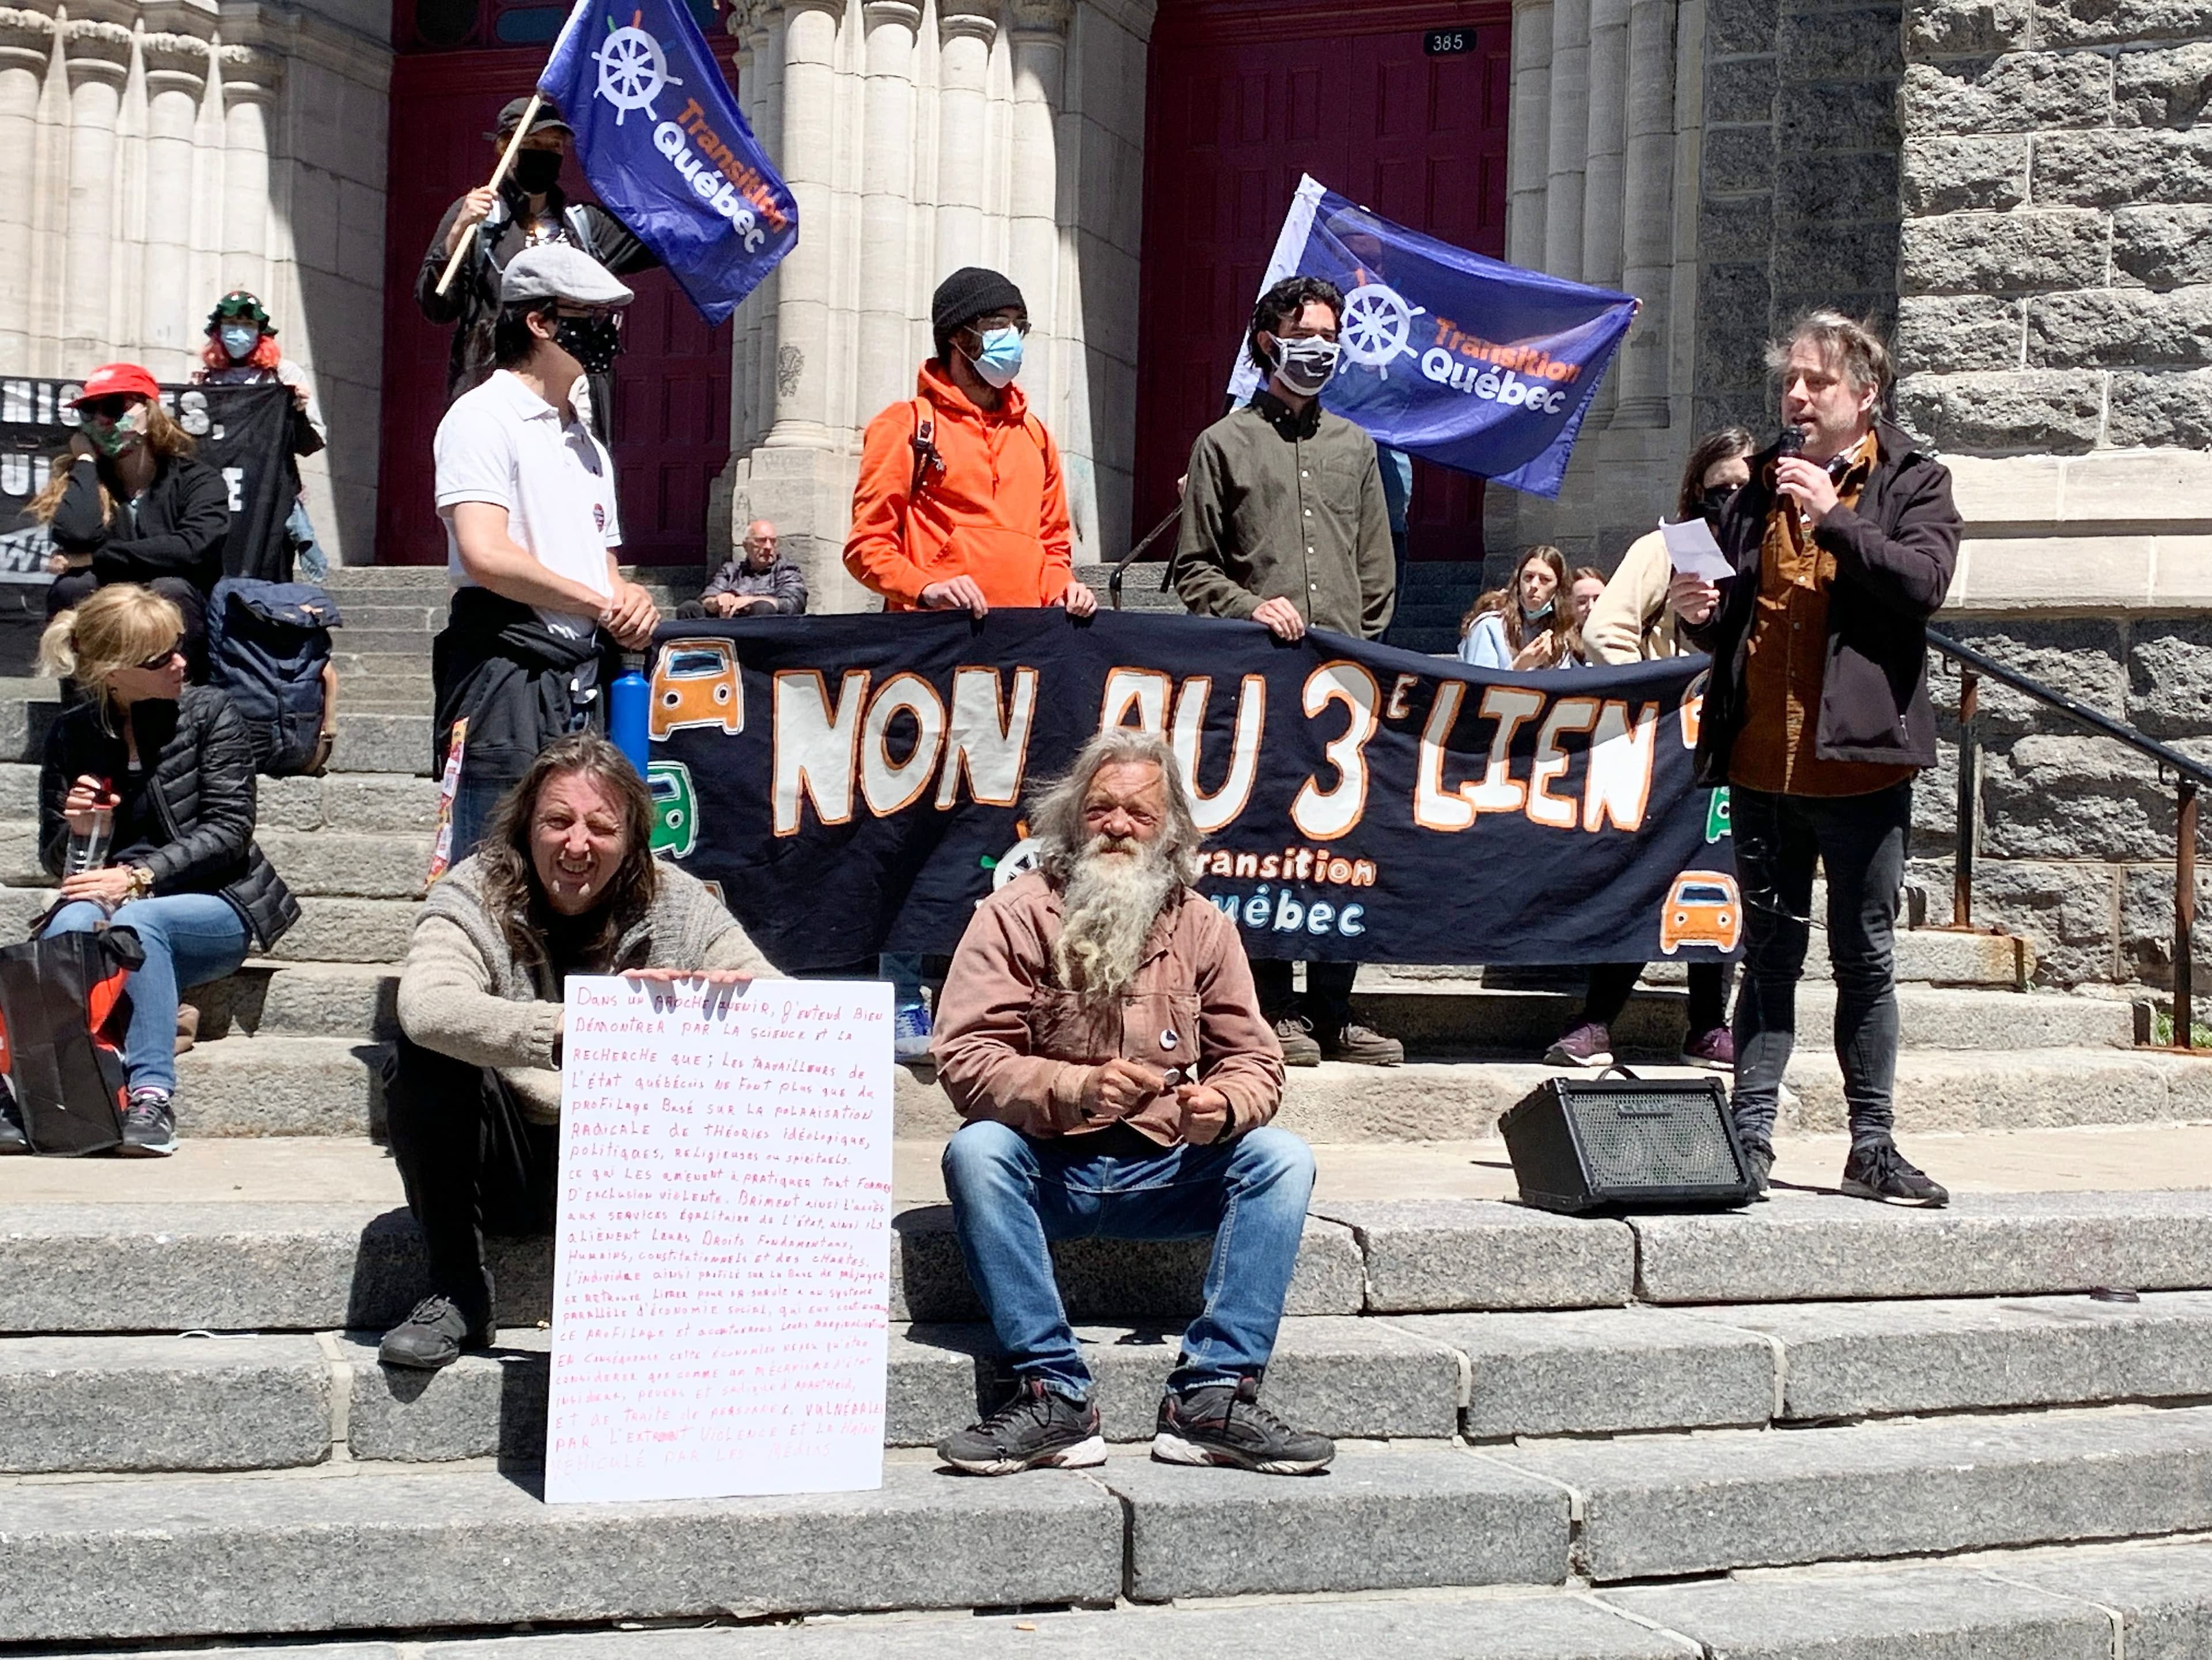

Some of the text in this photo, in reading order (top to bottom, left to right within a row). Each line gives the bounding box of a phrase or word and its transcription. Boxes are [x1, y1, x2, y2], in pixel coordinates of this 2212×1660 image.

[1433, 34, 1463, 51] 385
[653, 121, 765, 254] Québec
[677, 97, 787, 235] Transition
[1421, 347, 1566, 415] Québec
[1433, 317, 1582, 384] Transition
[773, 665, 1039, 837] NON
[1413, 680, 1660, 833] LIEN
[1196, 847, 1377, 886] ransition
[1210, 883, 1366, 936] uébec
